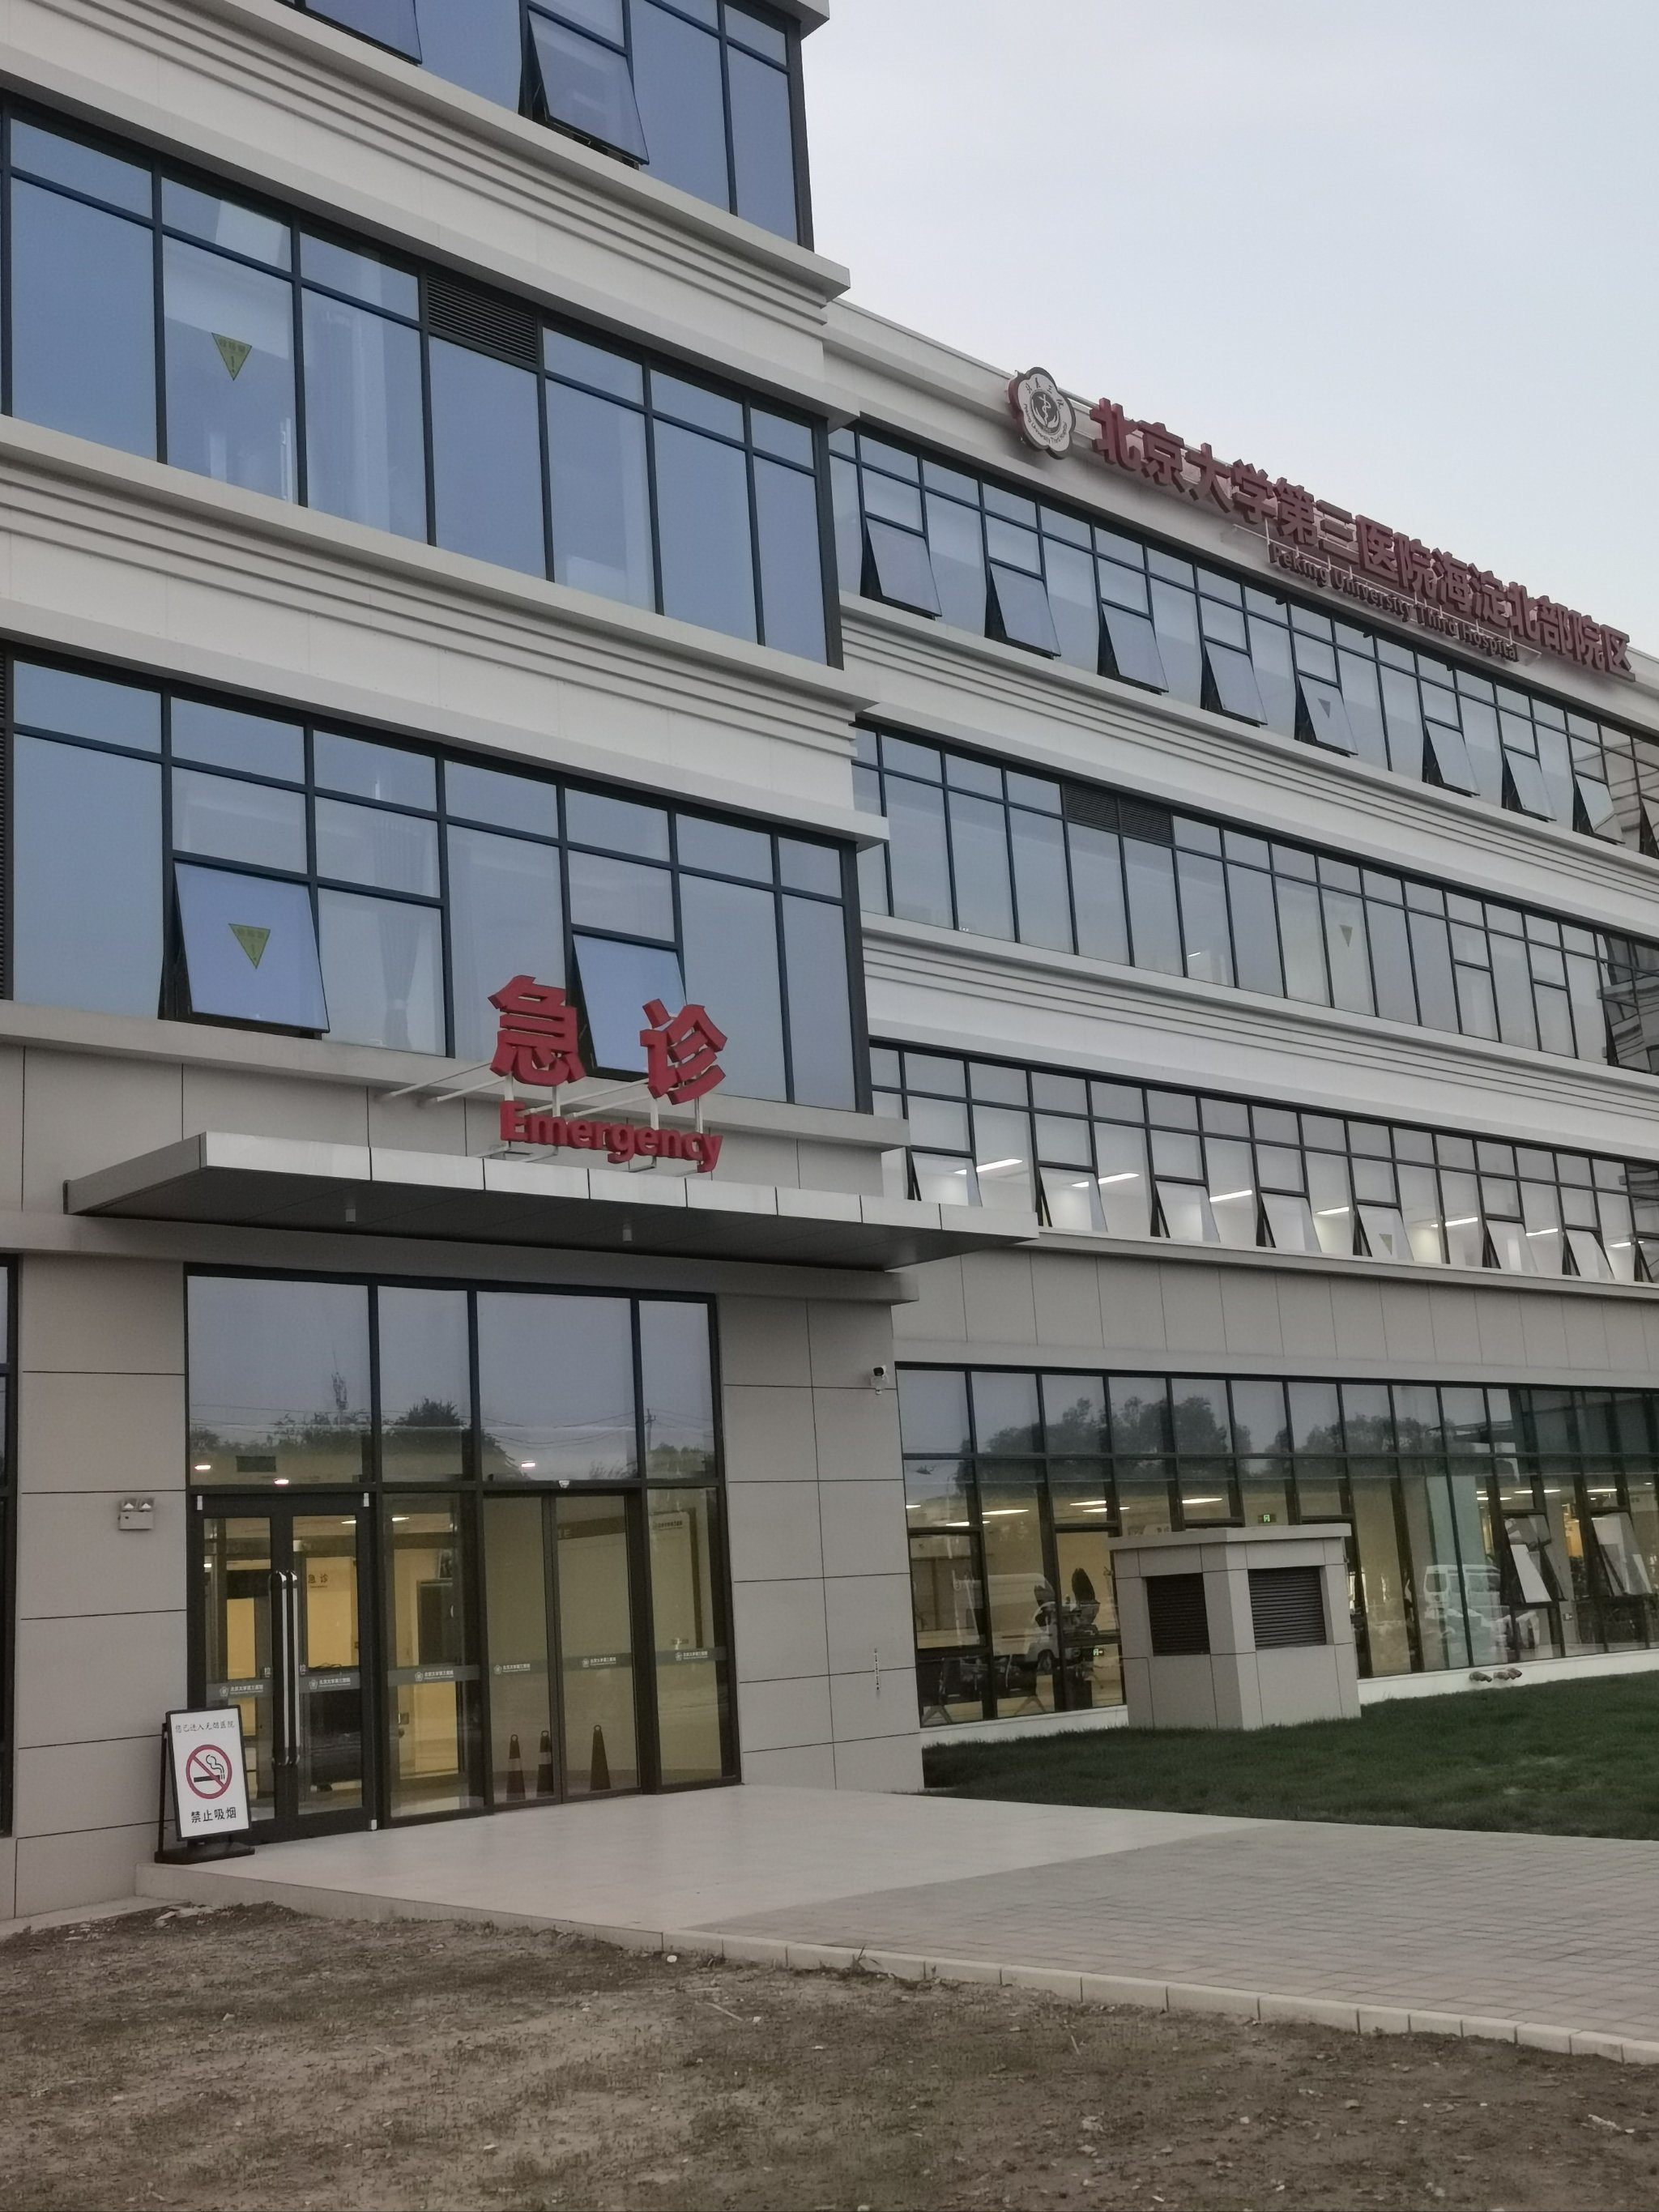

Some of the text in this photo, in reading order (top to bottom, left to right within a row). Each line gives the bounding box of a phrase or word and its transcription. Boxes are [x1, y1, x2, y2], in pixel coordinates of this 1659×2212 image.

[1090, 397, 1636, 682] 北京大学第三医院海淀北部院区
[1269, 542, 1520, 663] Peking University Third Hospital
[487, 974, 728, 1105] 急诊
[500, 1100, 723, 1173] Emergency
[190, 1806, 237, 1823] 禁止吸烟
